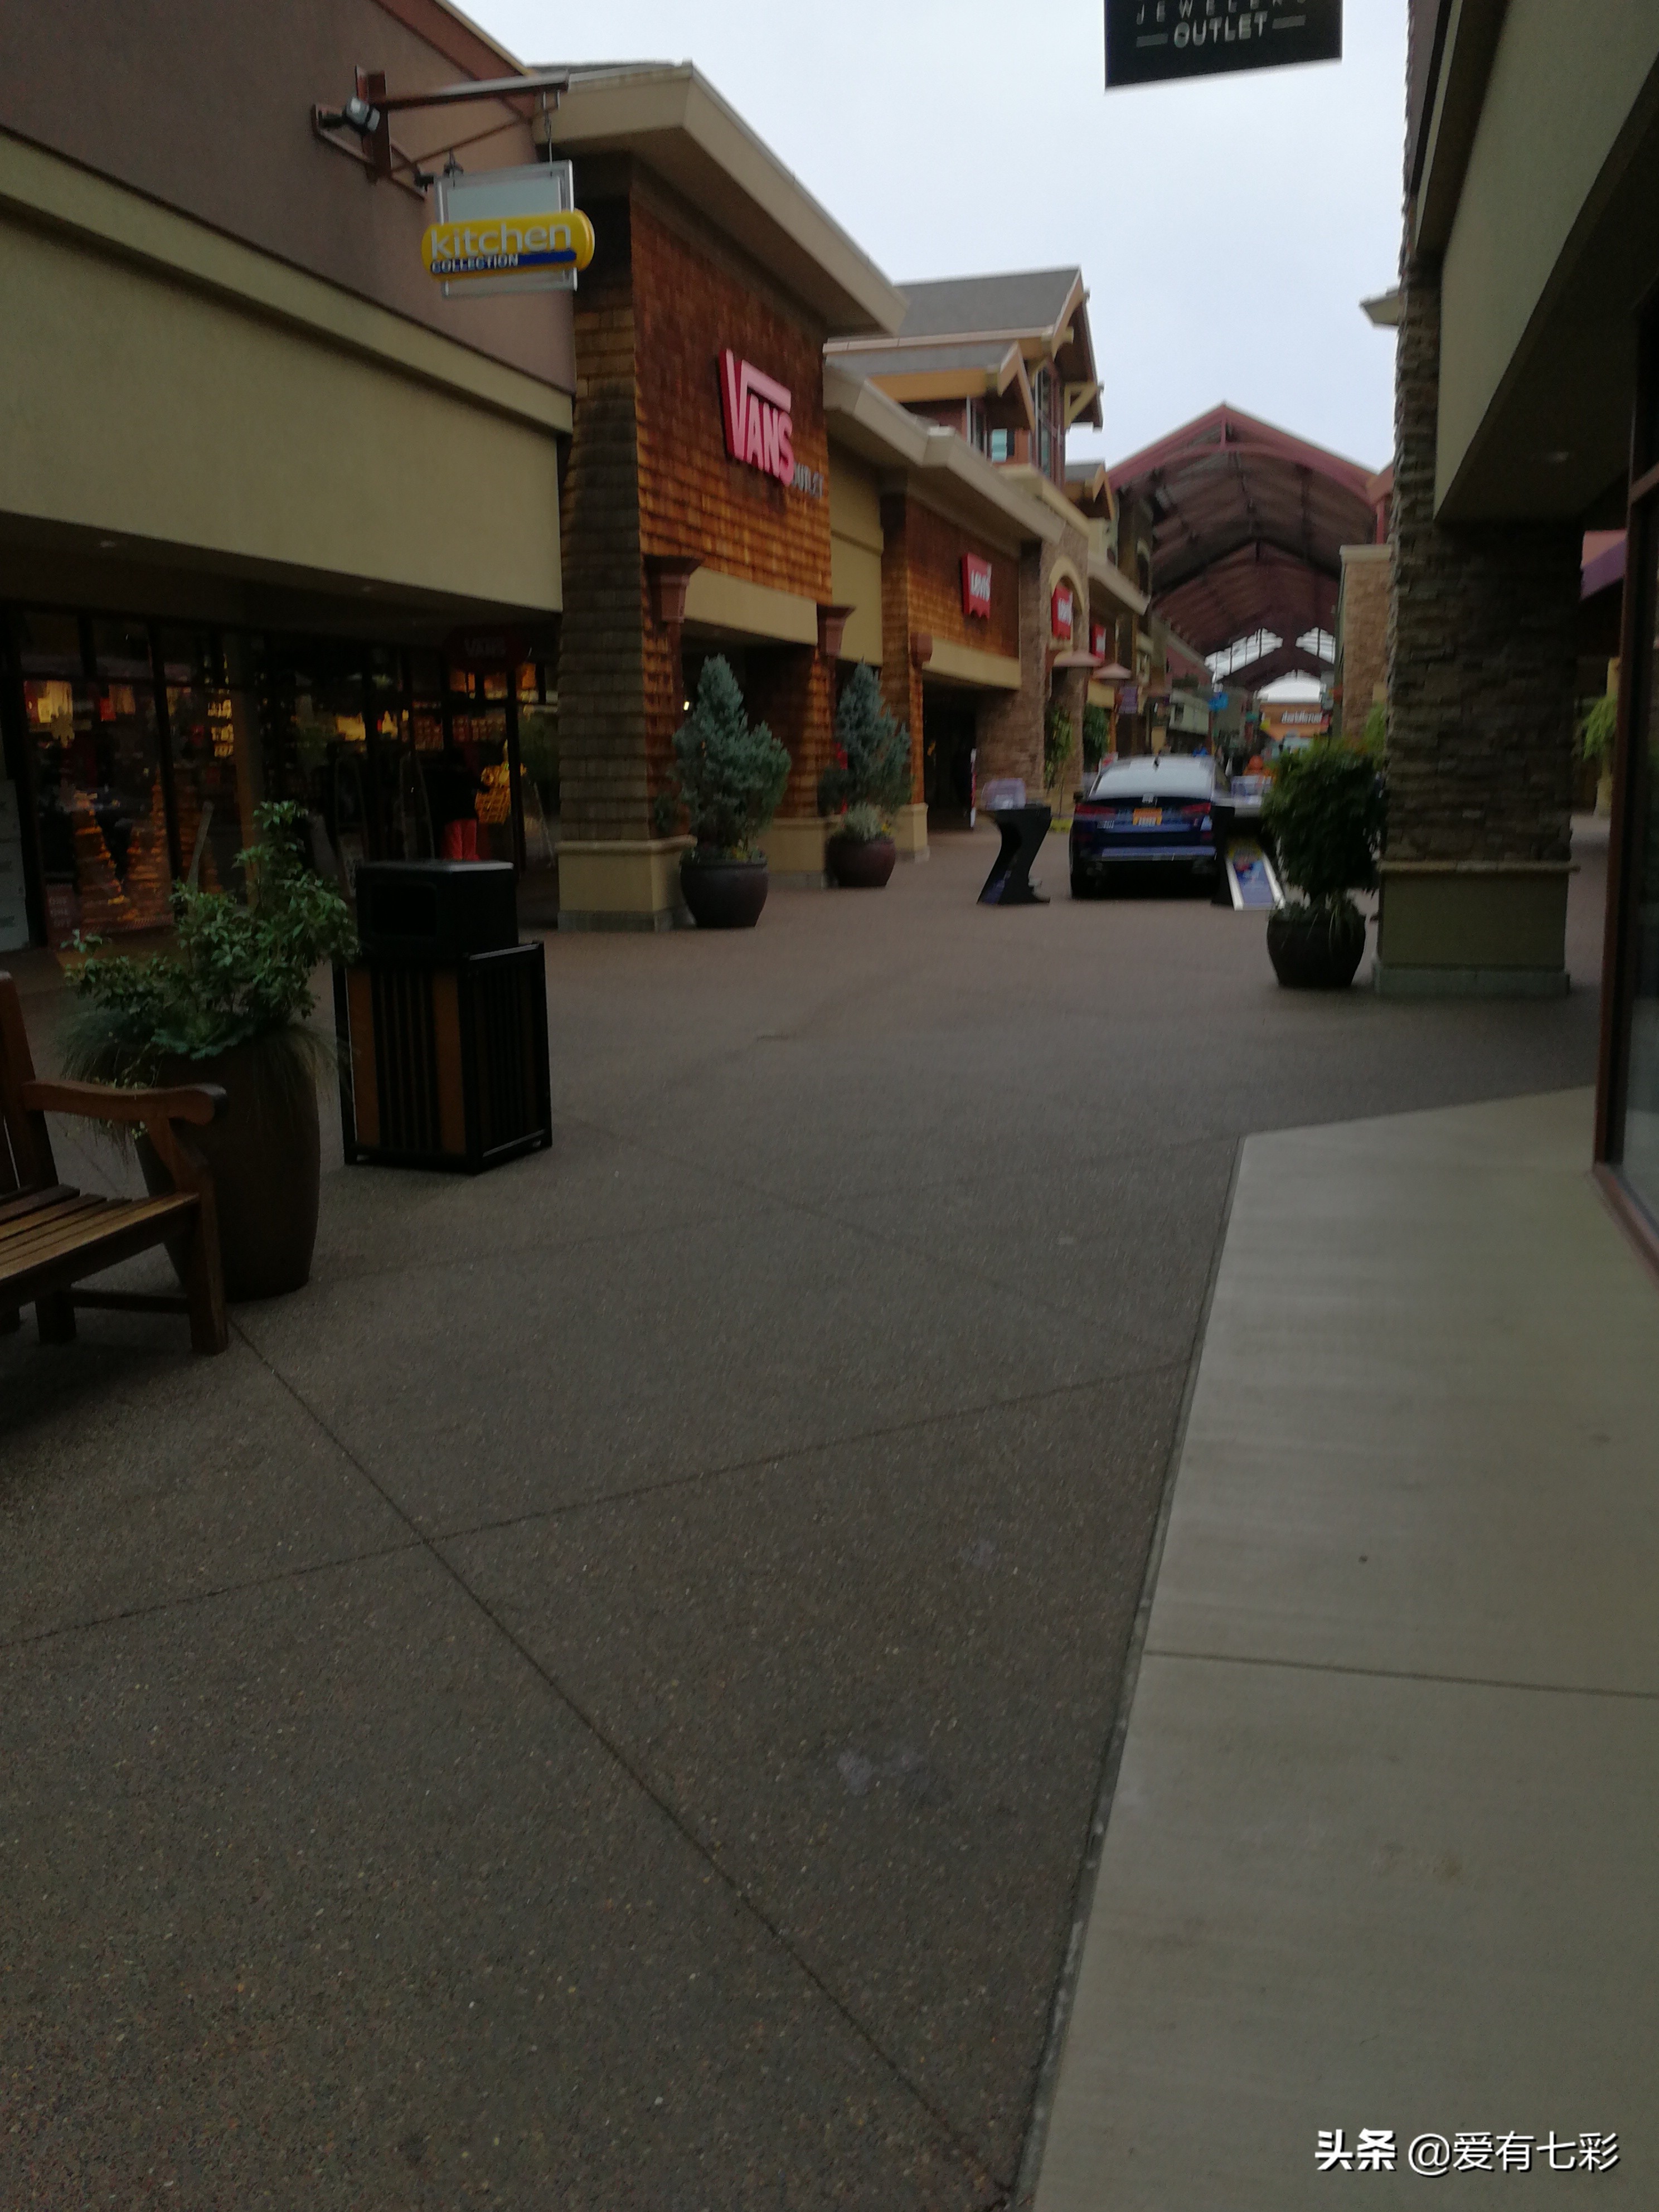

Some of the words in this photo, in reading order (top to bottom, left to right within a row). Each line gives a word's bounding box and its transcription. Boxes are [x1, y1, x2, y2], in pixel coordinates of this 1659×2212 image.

[1136, 0, 1306, 25] JEWEL
[1173, 11, 1268, 48] OUTLET
[431, 222, 571, 260] kitchen
[431, 254, 518, 274] COLLECTION
[723, 348, 794, 487] VANS
